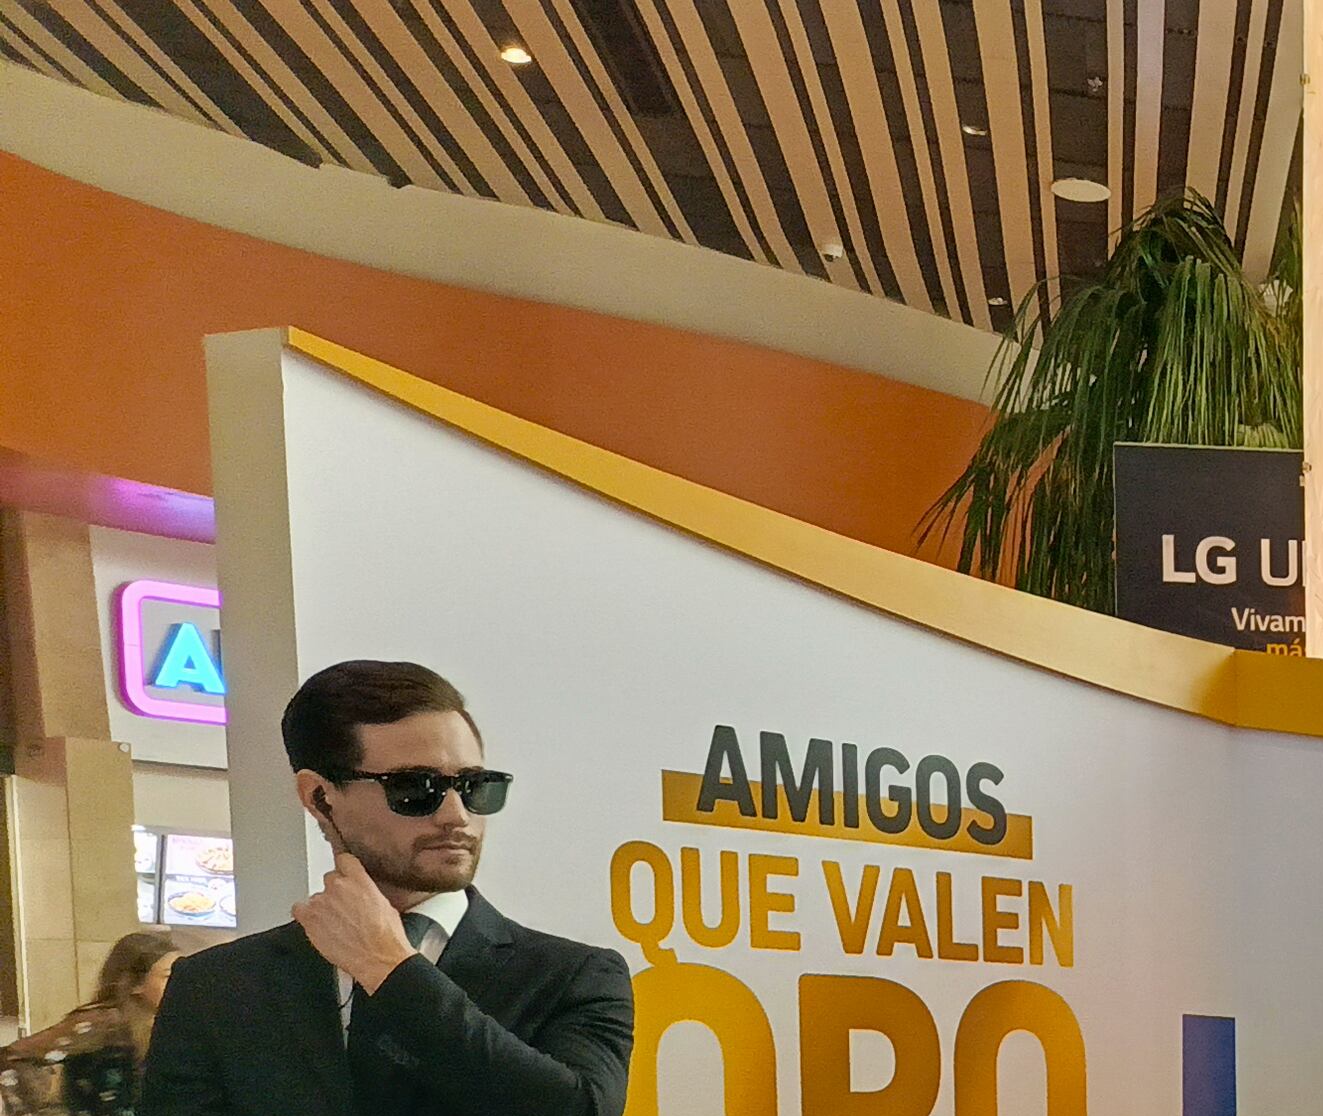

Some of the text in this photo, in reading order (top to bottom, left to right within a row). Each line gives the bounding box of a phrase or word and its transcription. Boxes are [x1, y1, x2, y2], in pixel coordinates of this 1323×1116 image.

[1161, 534, 1306, 588] LG U
[153, 622, 226, 695] A
[696, 724, 1008, 846] AMIGOS
[609, 840, 1074, 968] QUE VALEN
